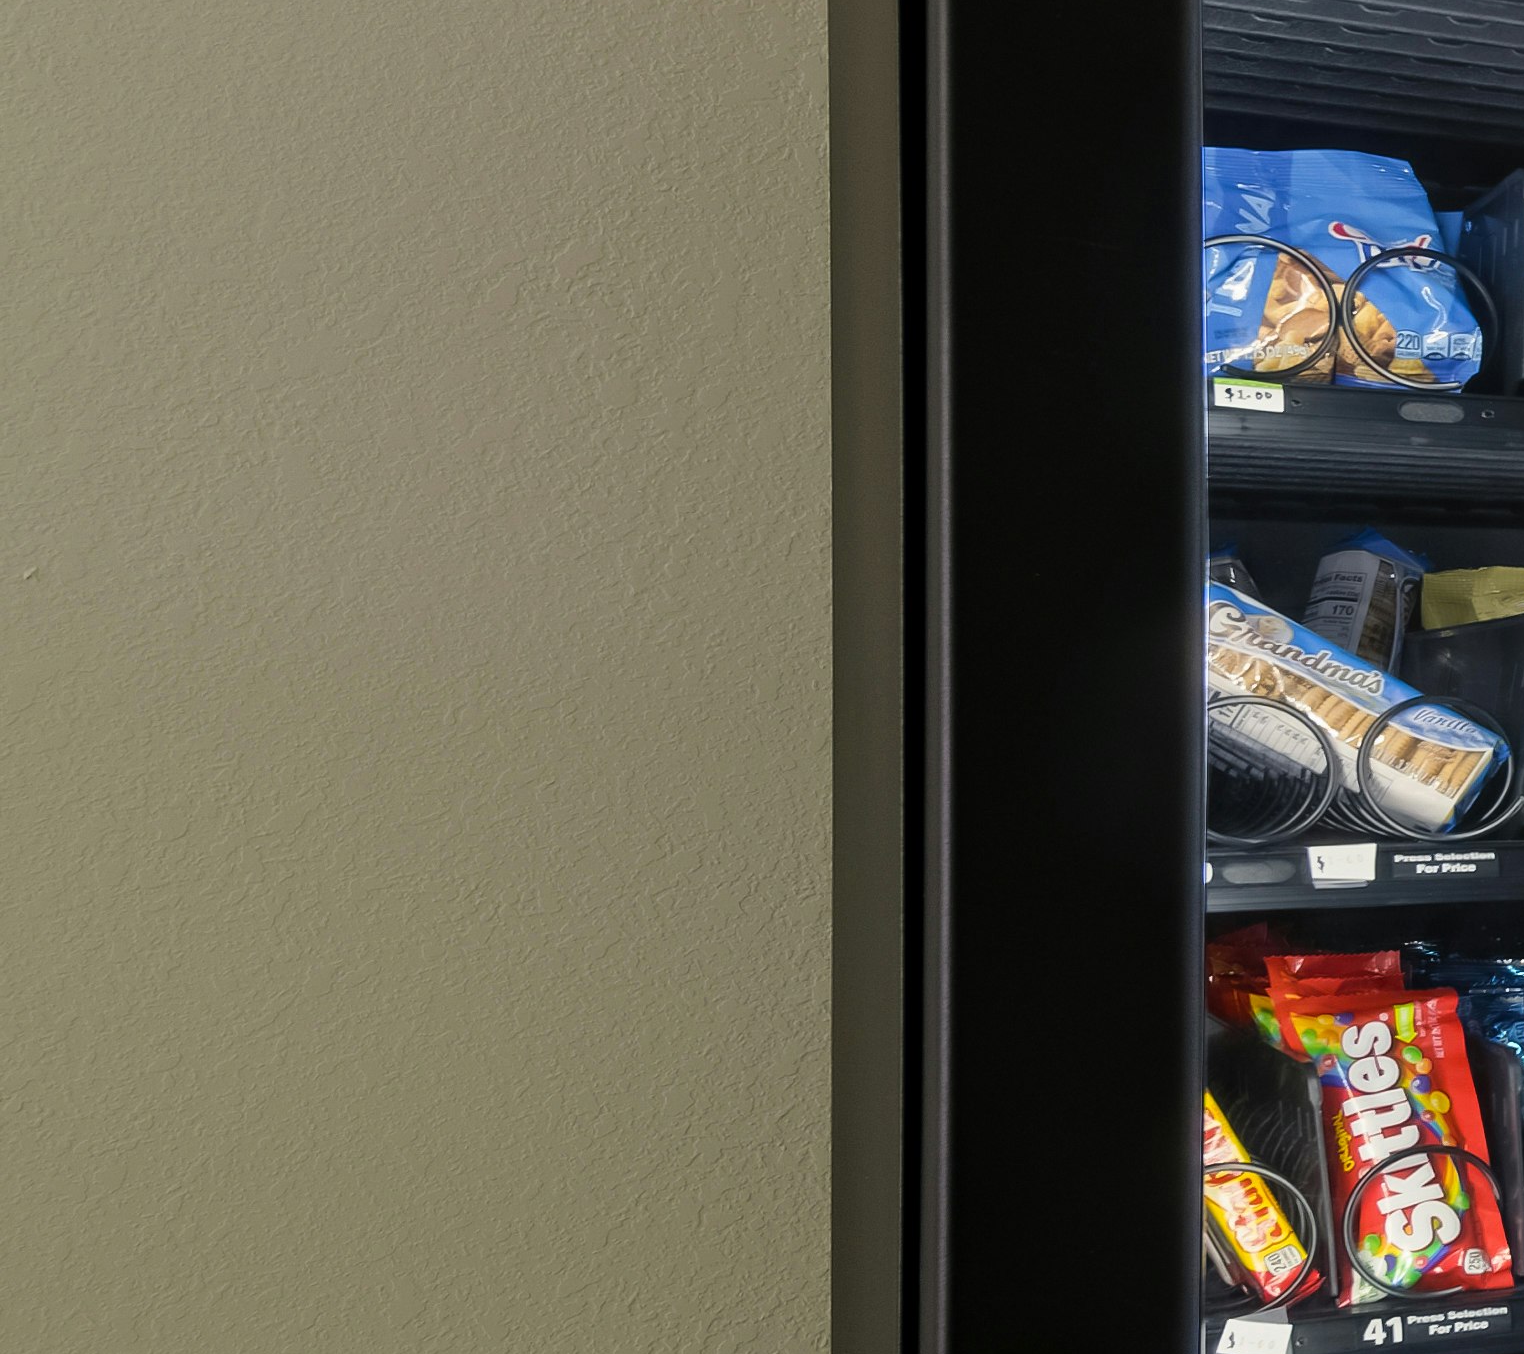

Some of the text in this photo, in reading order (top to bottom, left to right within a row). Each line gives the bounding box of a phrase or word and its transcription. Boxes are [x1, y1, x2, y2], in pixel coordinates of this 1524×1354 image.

[1397, 331, 1420, 351] 220
[1331, 604, 1356, 617] 170
[1208, 599, 1386, 695] Grandma's
[1342, 1019, 1463, 1254] Skittles
[1266, 1253, 1288, 1275] 240
[1467, 1249, 1480, 1273] 250
[1407, 1306, 1508, 1326] Press Selection
[1363, 1317, 1406, 1346] 41
[1429, 1319, 1489, 1336] For Price
